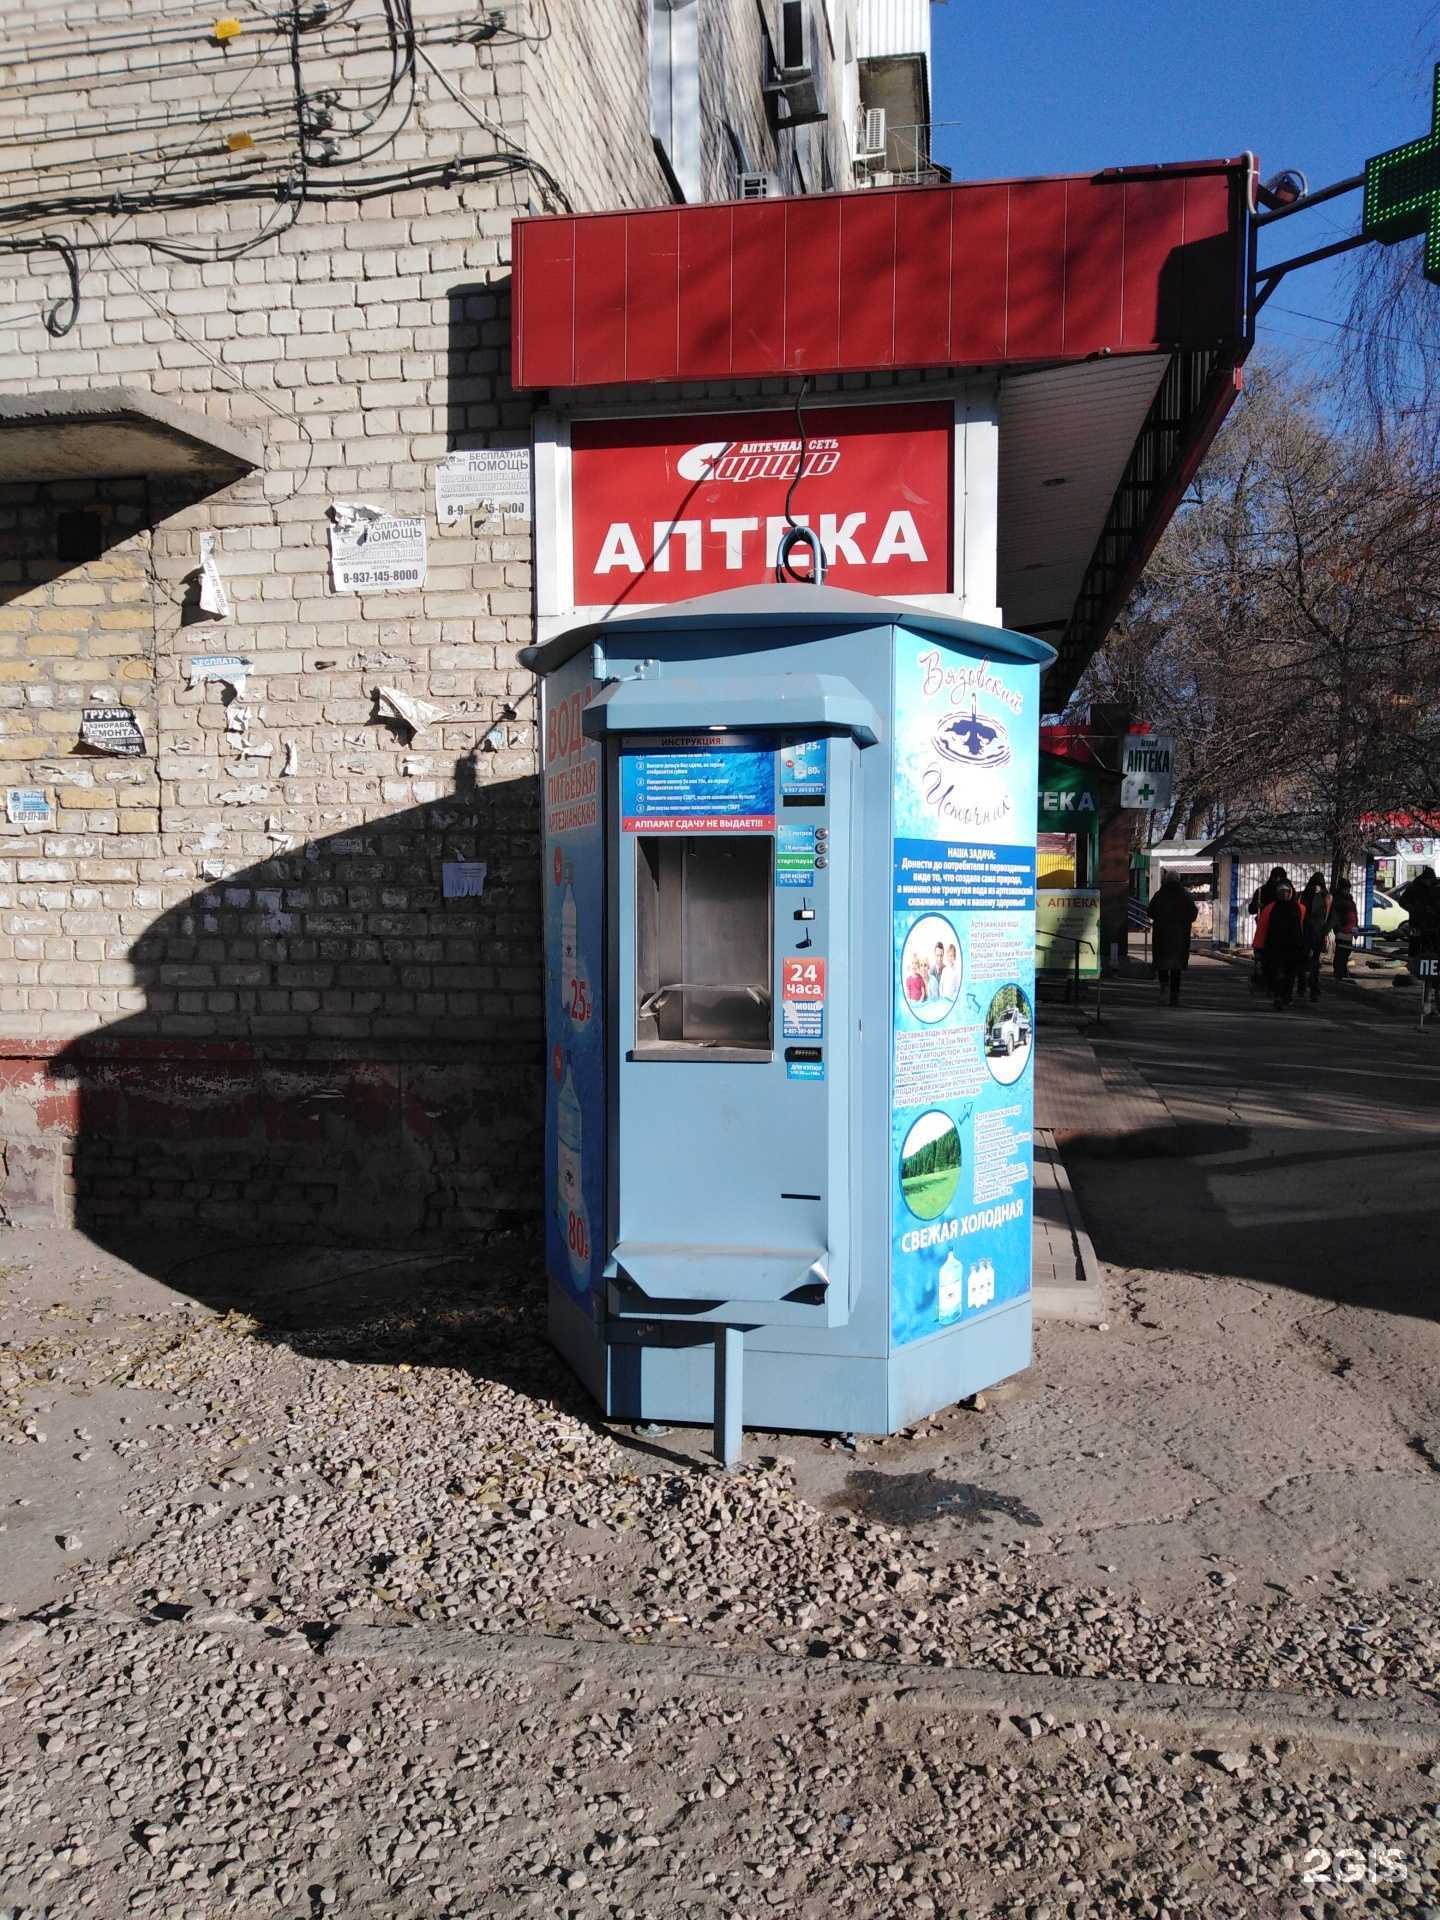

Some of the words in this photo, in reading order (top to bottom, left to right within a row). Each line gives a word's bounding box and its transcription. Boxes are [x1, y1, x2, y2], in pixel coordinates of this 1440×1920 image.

[740, 441, 803, 454] АПТЕЧНАЯ
[808, 439, 839, 451] СЕТЬ
[469, 450, 529, 461] БЕСПЛАТНАЯ
[468, 459, 529, 472] ПОМОЩЬ
[365, 519, 421, 531] СПЛАТНАЯ
[593, 510, 928, 574] АПТЕКА
[343, 569, 418, 584] 8-937-145-8000
[84, 708, 130, 719] ГРУЗЧИ
[661, 737, 721, 746] ИНСТРУКЦИЯ
[1126, 749, 1169, 773] АПТЕКА
[549, 760, 596, 804] ПИТЬЕВАЯ
[635, 820, 674, 829] АППАРАТ
[676, 820, 704, 829] СДАЧУ
[707, 820, 717, 828] НЕ
[947, 847, 968, 858] НАША
[969, 848, 996, 860] ЗАДАЧА:
[902, 857, 932, 870] Донести
[933, 861, 943, 871] до
[943, 874, 955, 882] что
[1048, 897, 1098, 908] АПТЕКА
[790, 963, 818, 982] 24
[786, 983, 821, 995] часа
[901, 1220, 958, 1253] СВЕЖАЯ
[961, 1199, 1024, 1234] ХОЛОДНАЯ
